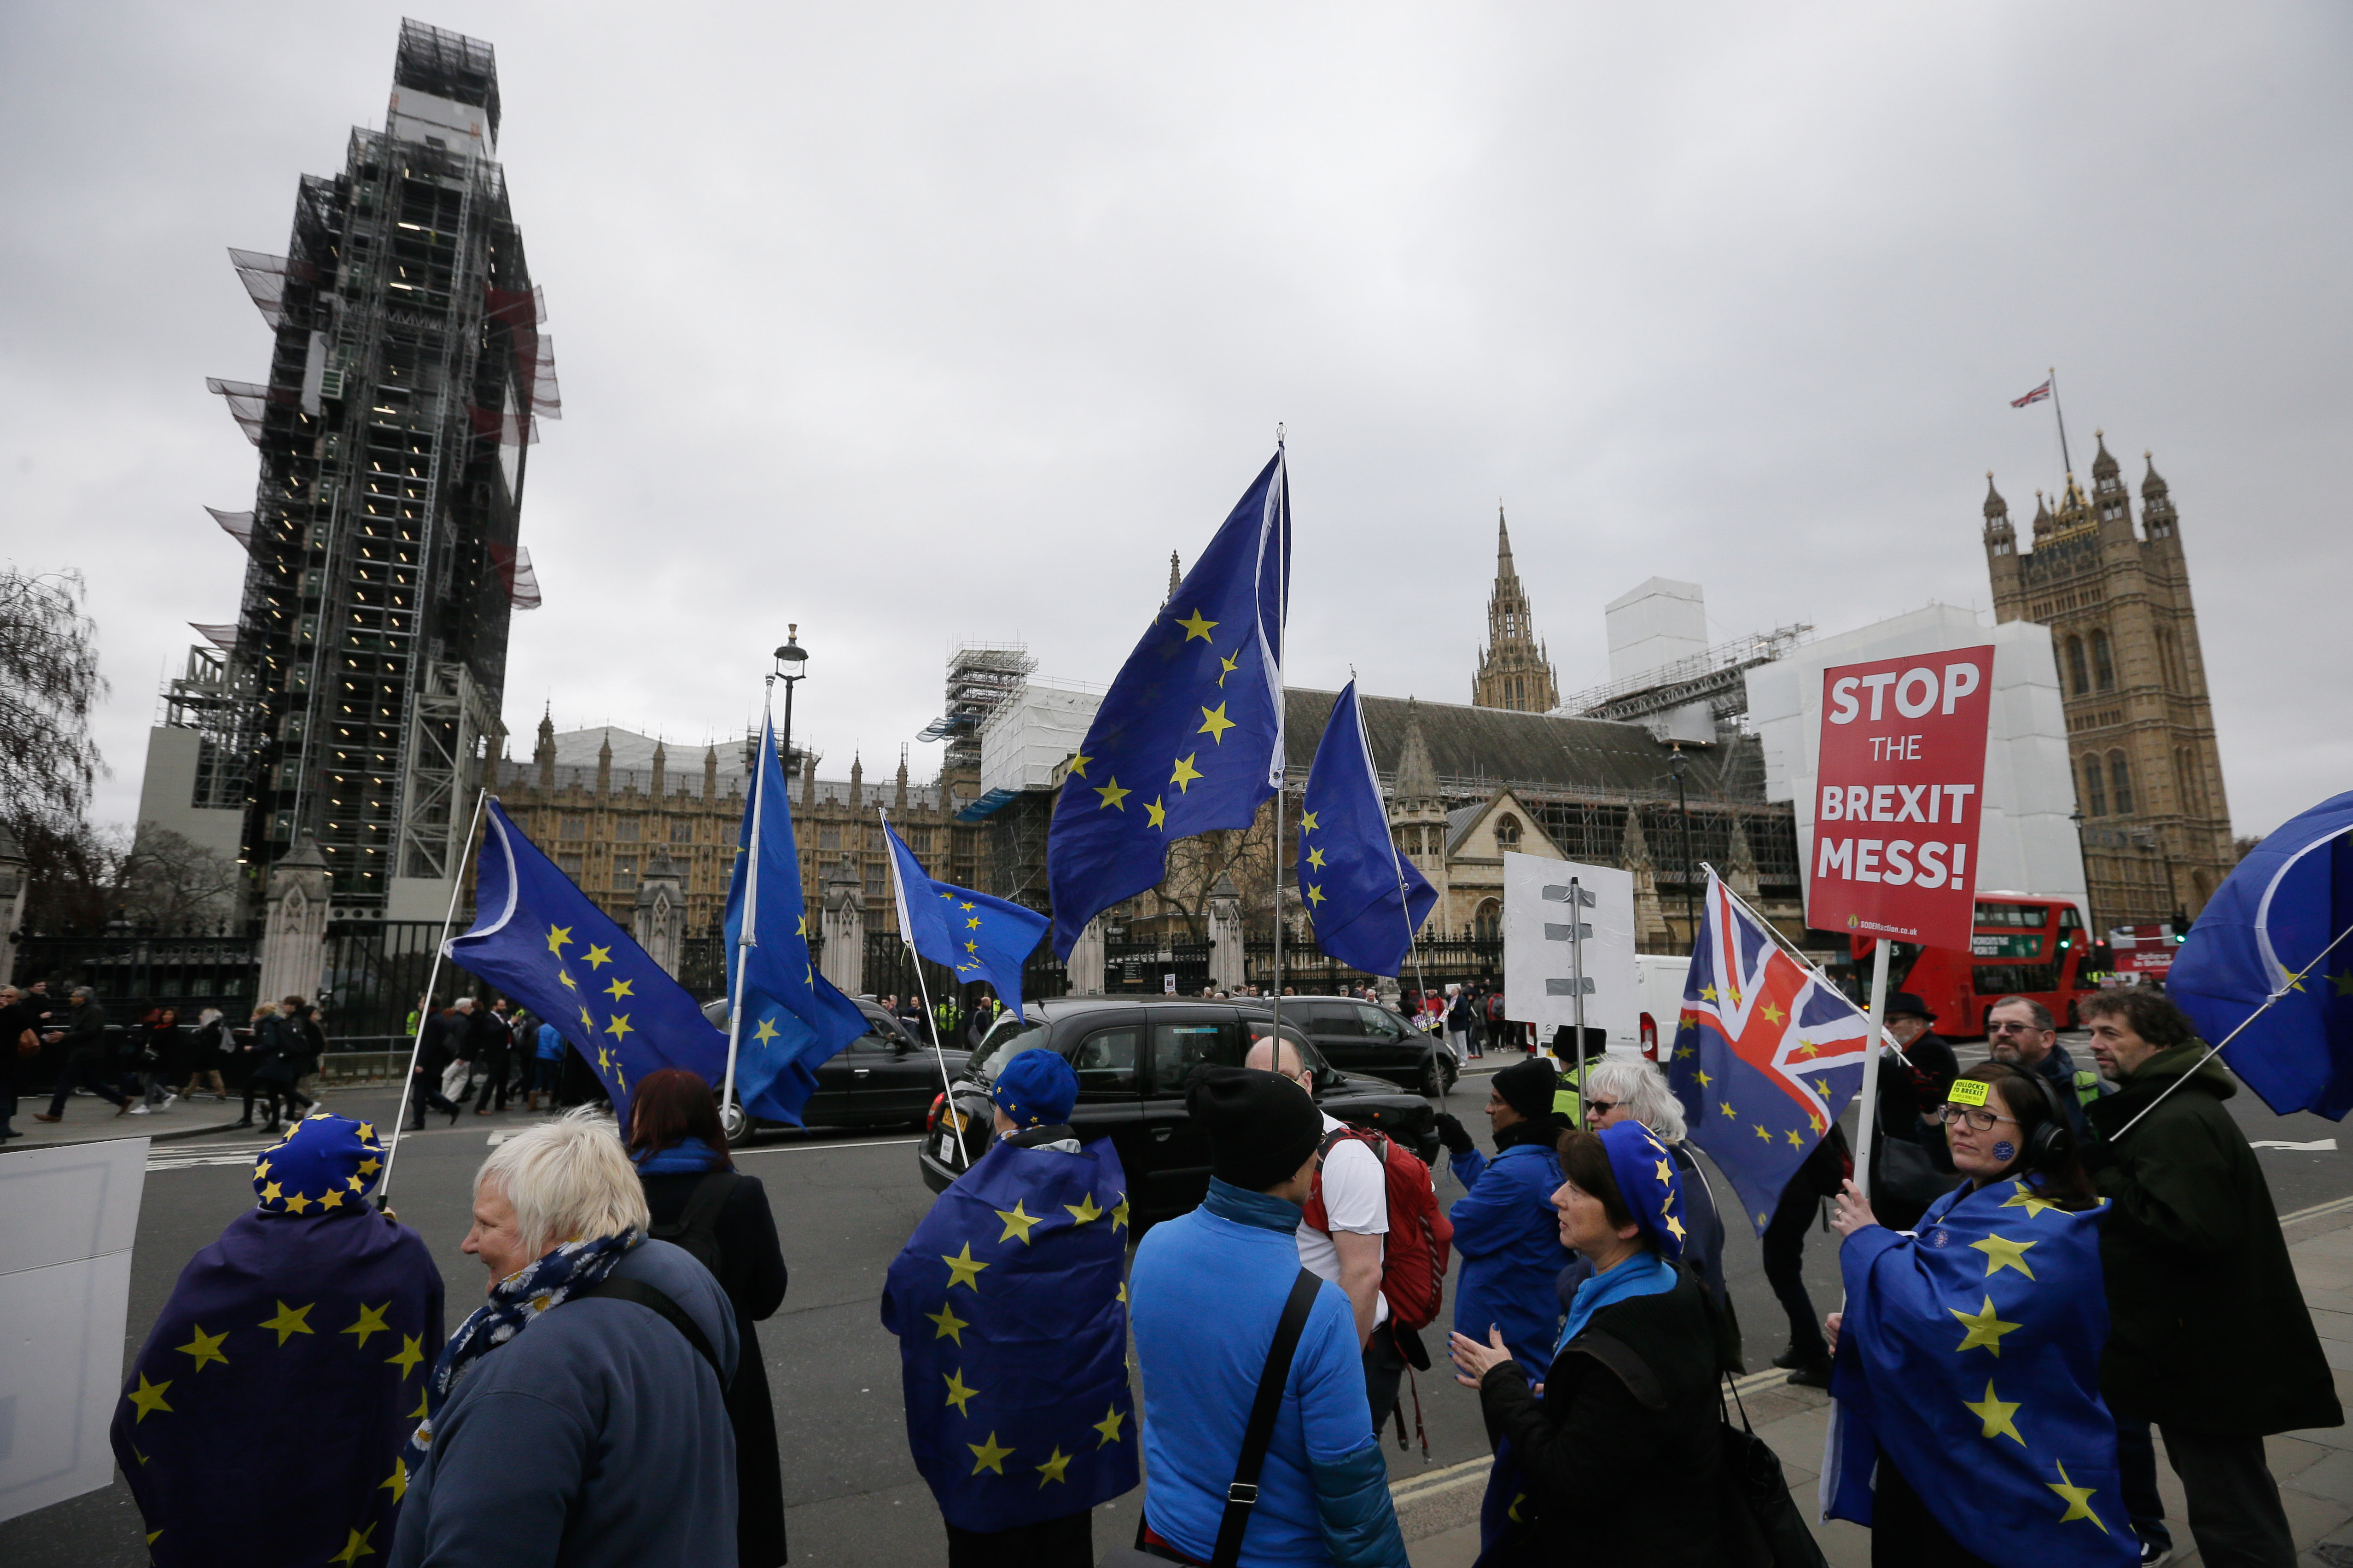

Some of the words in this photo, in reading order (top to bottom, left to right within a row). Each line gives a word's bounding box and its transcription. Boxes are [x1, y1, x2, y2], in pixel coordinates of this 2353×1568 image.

[1829, 662, 1980, 725] STOP
[1870, 735, 1922, 761] THE
[1821, 784, 1975, 824] BREXIT
[1818, 837, 1966, 890] MESS!
[1860, 920, 1918, 935] SODEMaction.co.uk
[1413, 1014, 1427, 1022] VOT
[1415, 1016, 1436, 1029] UKP
[1956, 1082, 1985, 1091] BOLLOCKS
[1961, 1088, 1983, 1096] BREXIT
